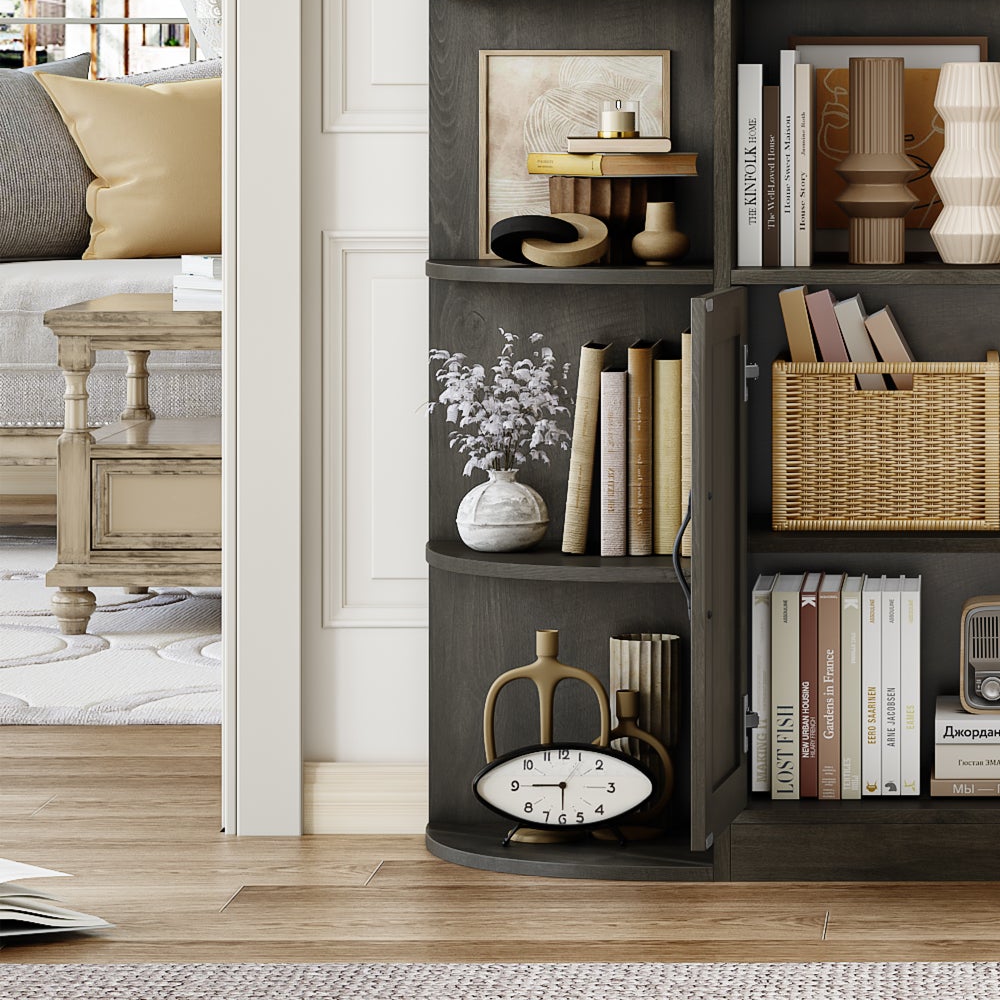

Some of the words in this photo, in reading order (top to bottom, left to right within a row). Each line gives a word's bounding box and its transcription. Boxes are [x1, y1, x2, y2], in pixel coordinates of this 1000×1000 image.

[744, 146, 757, 205] KINFOLK
[800, 171, 808, 198] Story
[823, 649, 835, 683] France
[802, 681, 810, 714] HOUSING
[823, 686, 835, 695] in
[868, 686, 877, 723] SAARINEN
[887, 687, 896, 725] JACOBSEN
[776, 704, 794, 744] FISH
[823, 698, 835, 739] Gardens
[906, 705, 915, 730] EAMES
[802, 715, 810, 740] URBAN
[868, 726, 877, 744] EERO
[887, 728, 896, 747] ARNE
[544, 752, 550, 761] 11
[558, 750, 570, 759] 12
[802, 742, 810, 758] NEW
[524, 760, 533, 770] 10
[595, 760, 604, 770] 2
[776, 748, 794, 794] LOST
[511, 780, 520, 791] 9
[607, 782, 616, 794] 3
[953, 783, 975, 794] МЫ
[524, 802, 533, 813] 8
[595, 804, 604, 815] 4
[543, 812, 550, 822] 7
[558, 814, 567, 824] 6
[576, 812, 584, 823] 5
